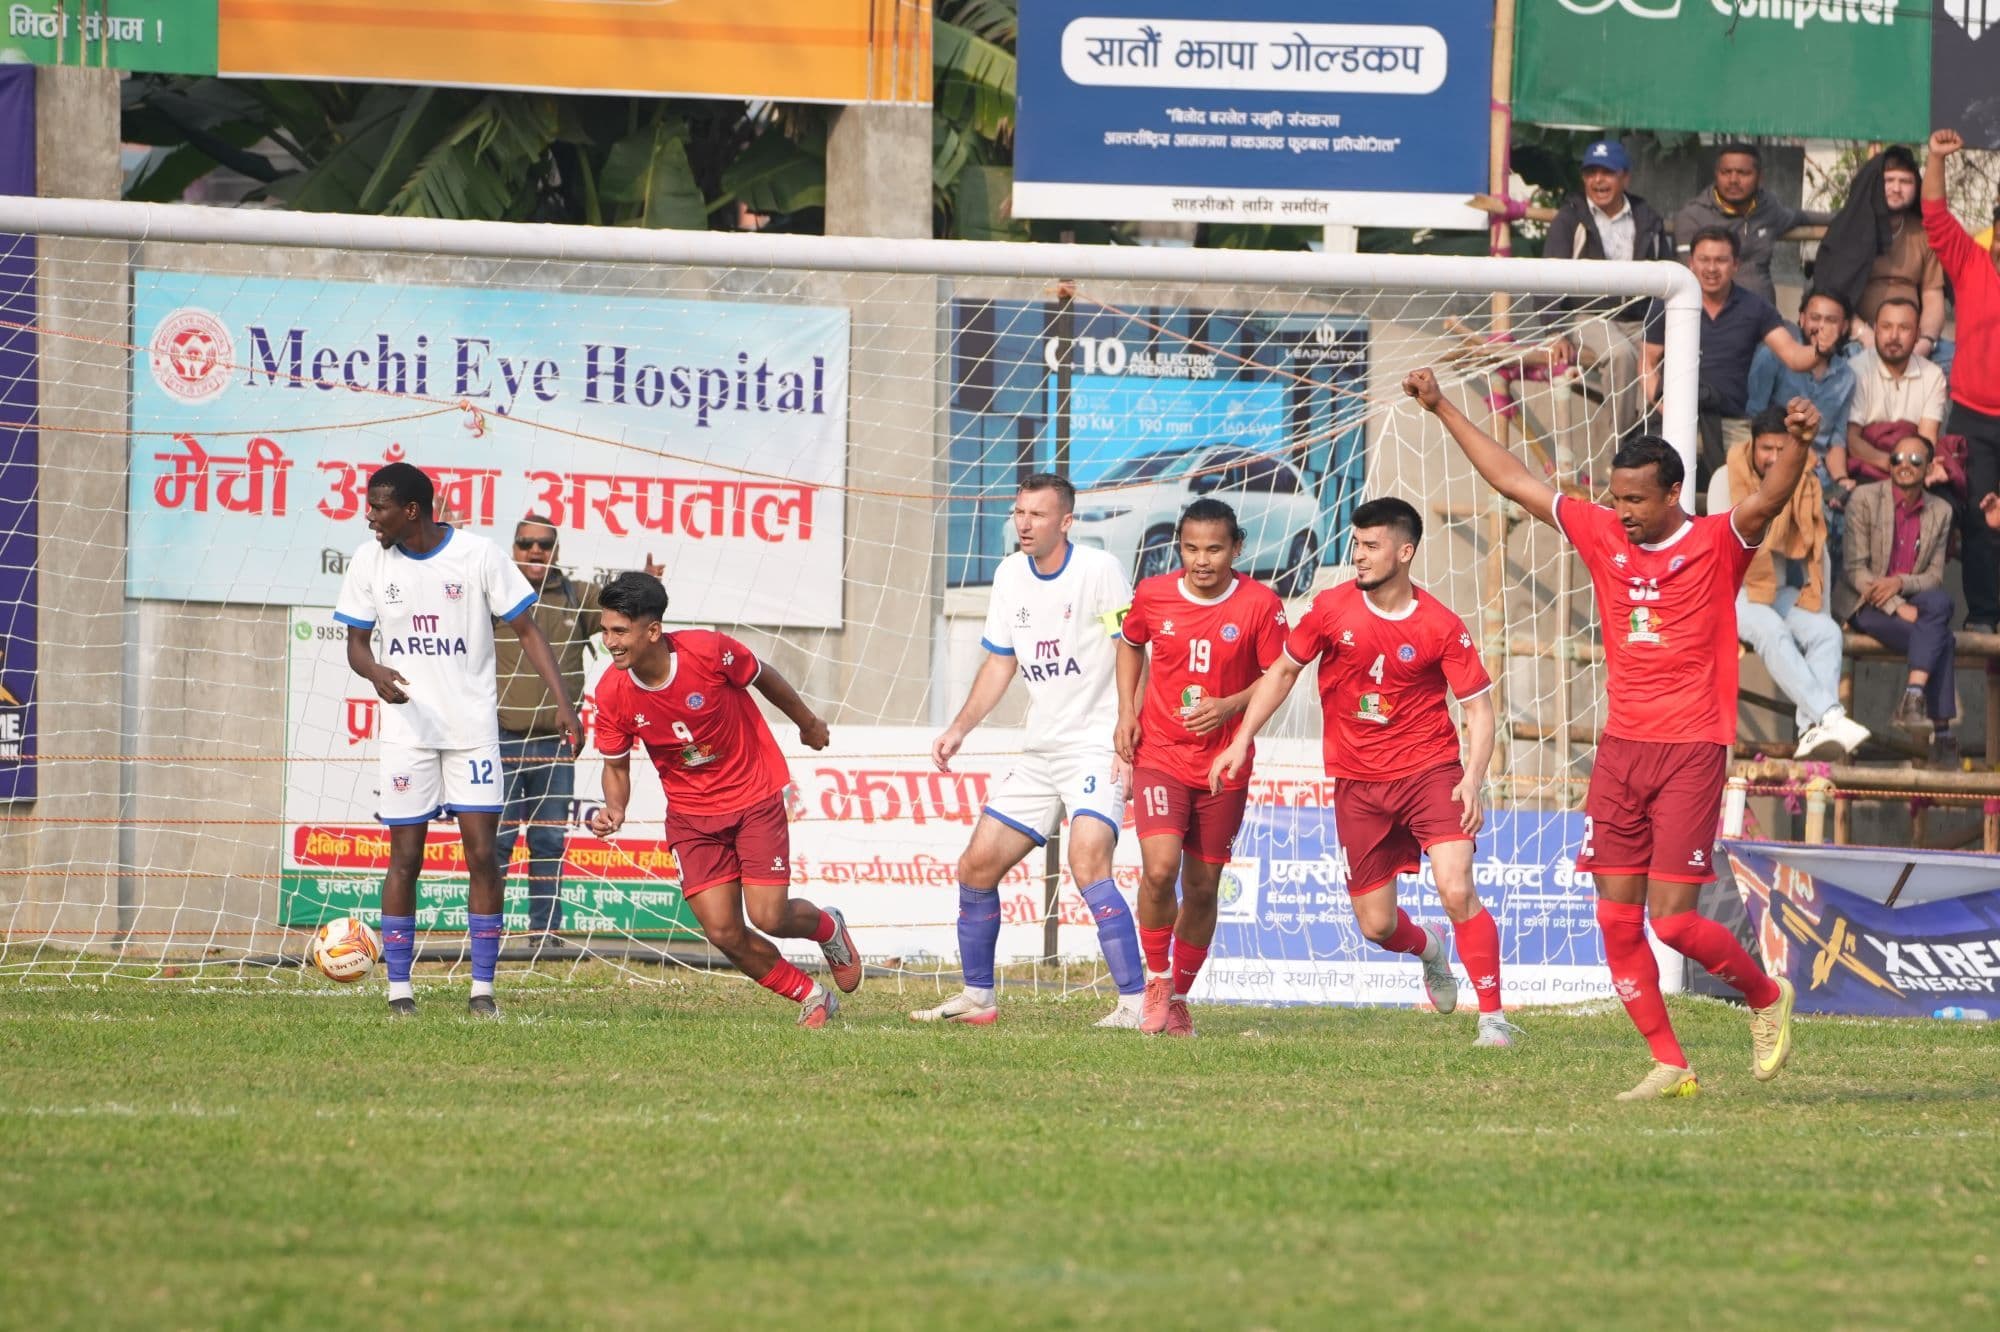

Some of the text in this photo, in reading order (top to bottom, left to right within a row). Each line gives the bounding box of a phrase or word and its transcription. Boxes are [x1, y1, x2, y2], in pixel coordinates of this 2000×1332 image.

[1086, 26, 1424, 75] सातौं झापा गोल्डकप
[244, 326, 827, 428] Mechi Eye Hospital
[154, 433, 294, 517] मेची
[524, 470, 819, 542] अस्पताल
[412, 614, 439, 634] MT
[389, 637, 467, 656] ARENA
[1035, 638, 1060, 660] MT
[1188, 639, 1211, 673] 19
[1368, 653, 1386, 685] 4
[671, 721, 694, 742] 9
[469, 760, 494, 785] 12
[1083, 776, 1096, 794] 3
[1143, 786, 1169, 817] 19
[1500, 976, 1546, 991] Local
[1890, 973, 1995, 992] ENERGY
